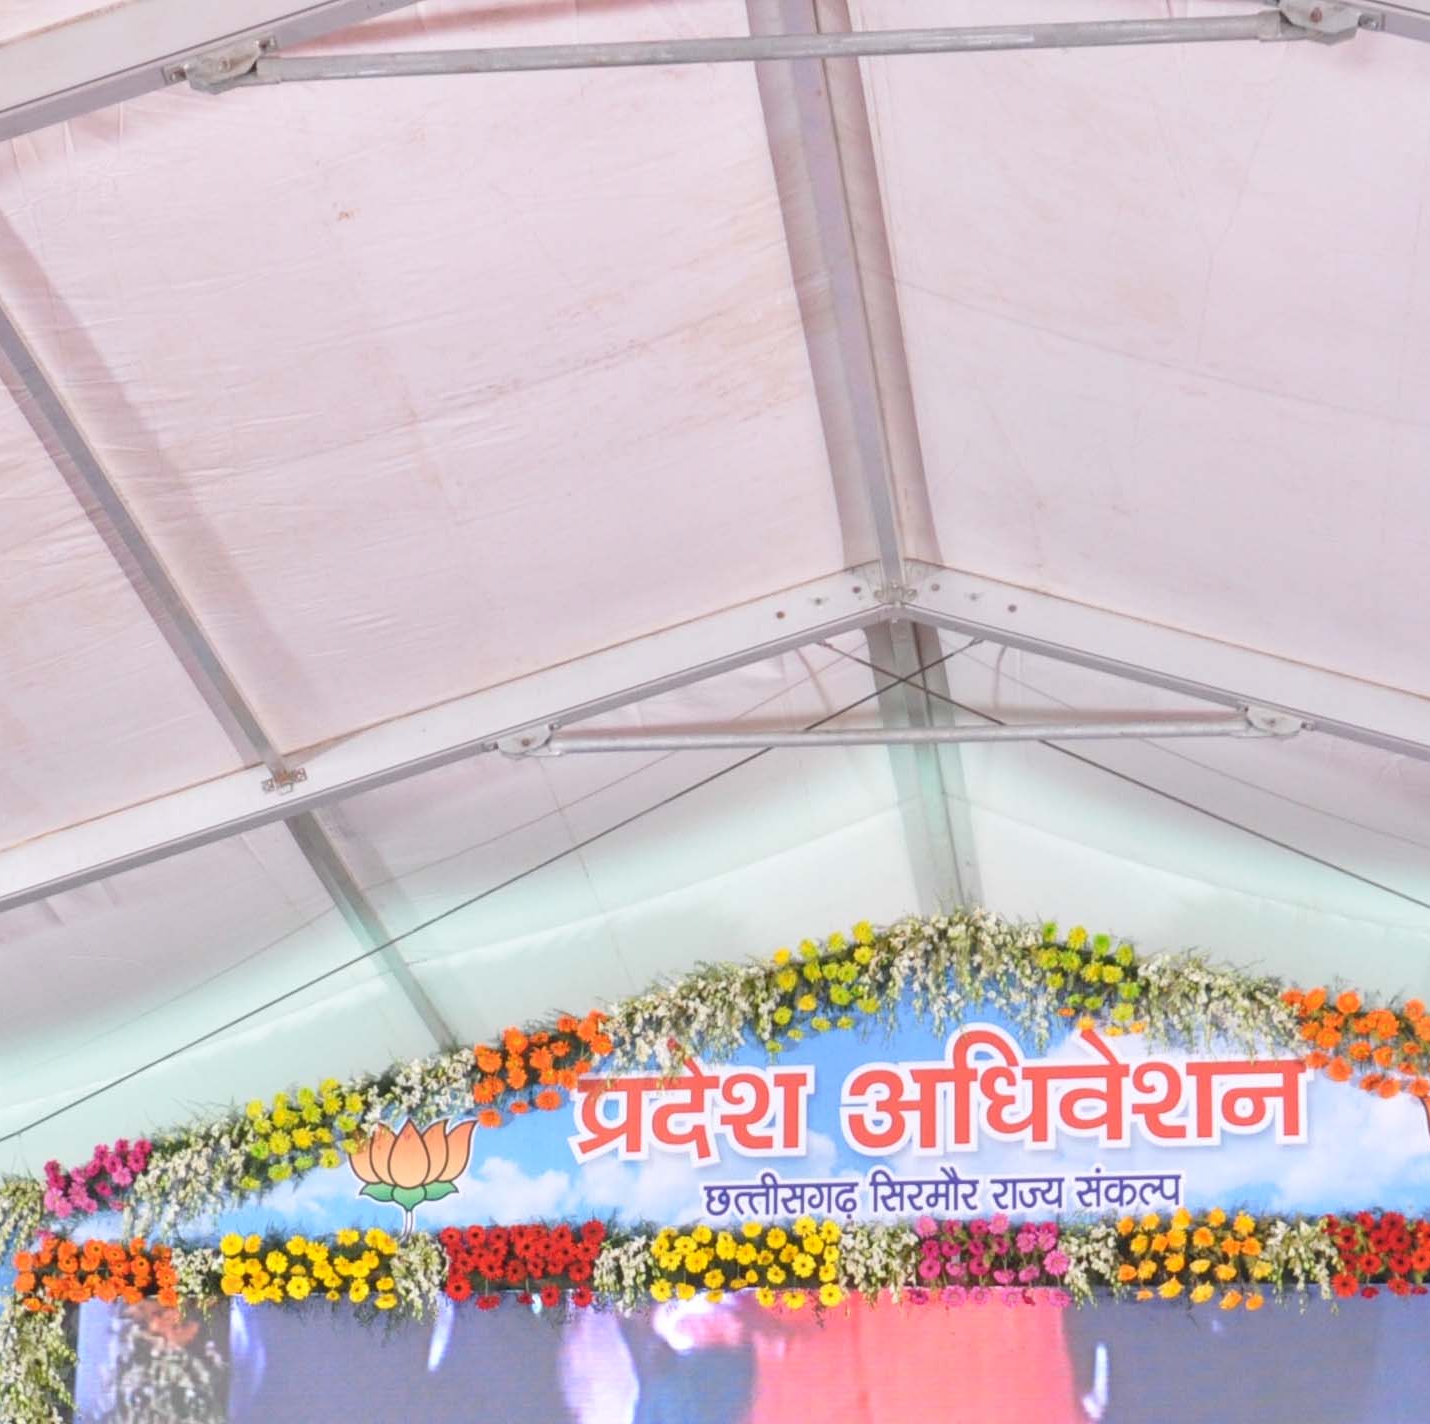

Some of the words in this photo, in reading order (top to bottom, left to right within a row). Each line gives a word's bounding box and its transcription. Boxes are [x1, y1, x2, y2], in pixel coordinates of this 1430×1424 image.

[577, 1040, 807, 1159] प्रदेश
[848, 1029, 1306, 1149] अधिवेशन
[704, 1171, 859, 1219] छत्तीसगढ़
[870, 1168, 979, 1213] सिरमौर
[991, 1176, 1065, 1210] राज्य
[1075, 1167, 1182, 1207] संकल्प
